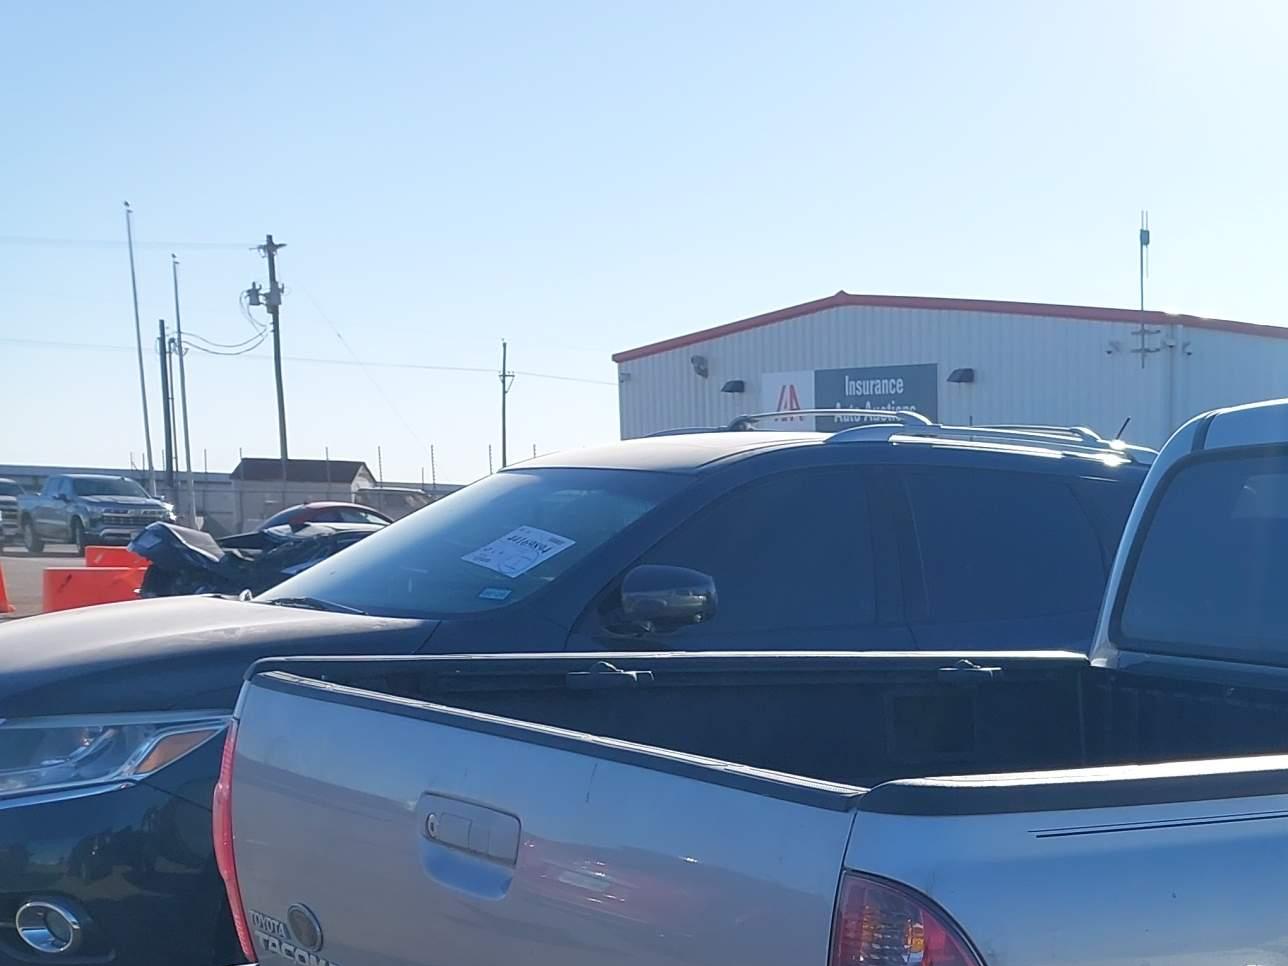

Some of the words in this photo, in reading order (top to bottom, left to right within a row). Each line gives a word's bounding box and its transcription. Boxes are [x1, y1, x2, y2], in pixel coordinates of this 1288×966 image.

[845, 375, 904, 396] Insurance
[834, 401, 860, 423] Auto
[250, 910, 289, 940] TOYOTA
